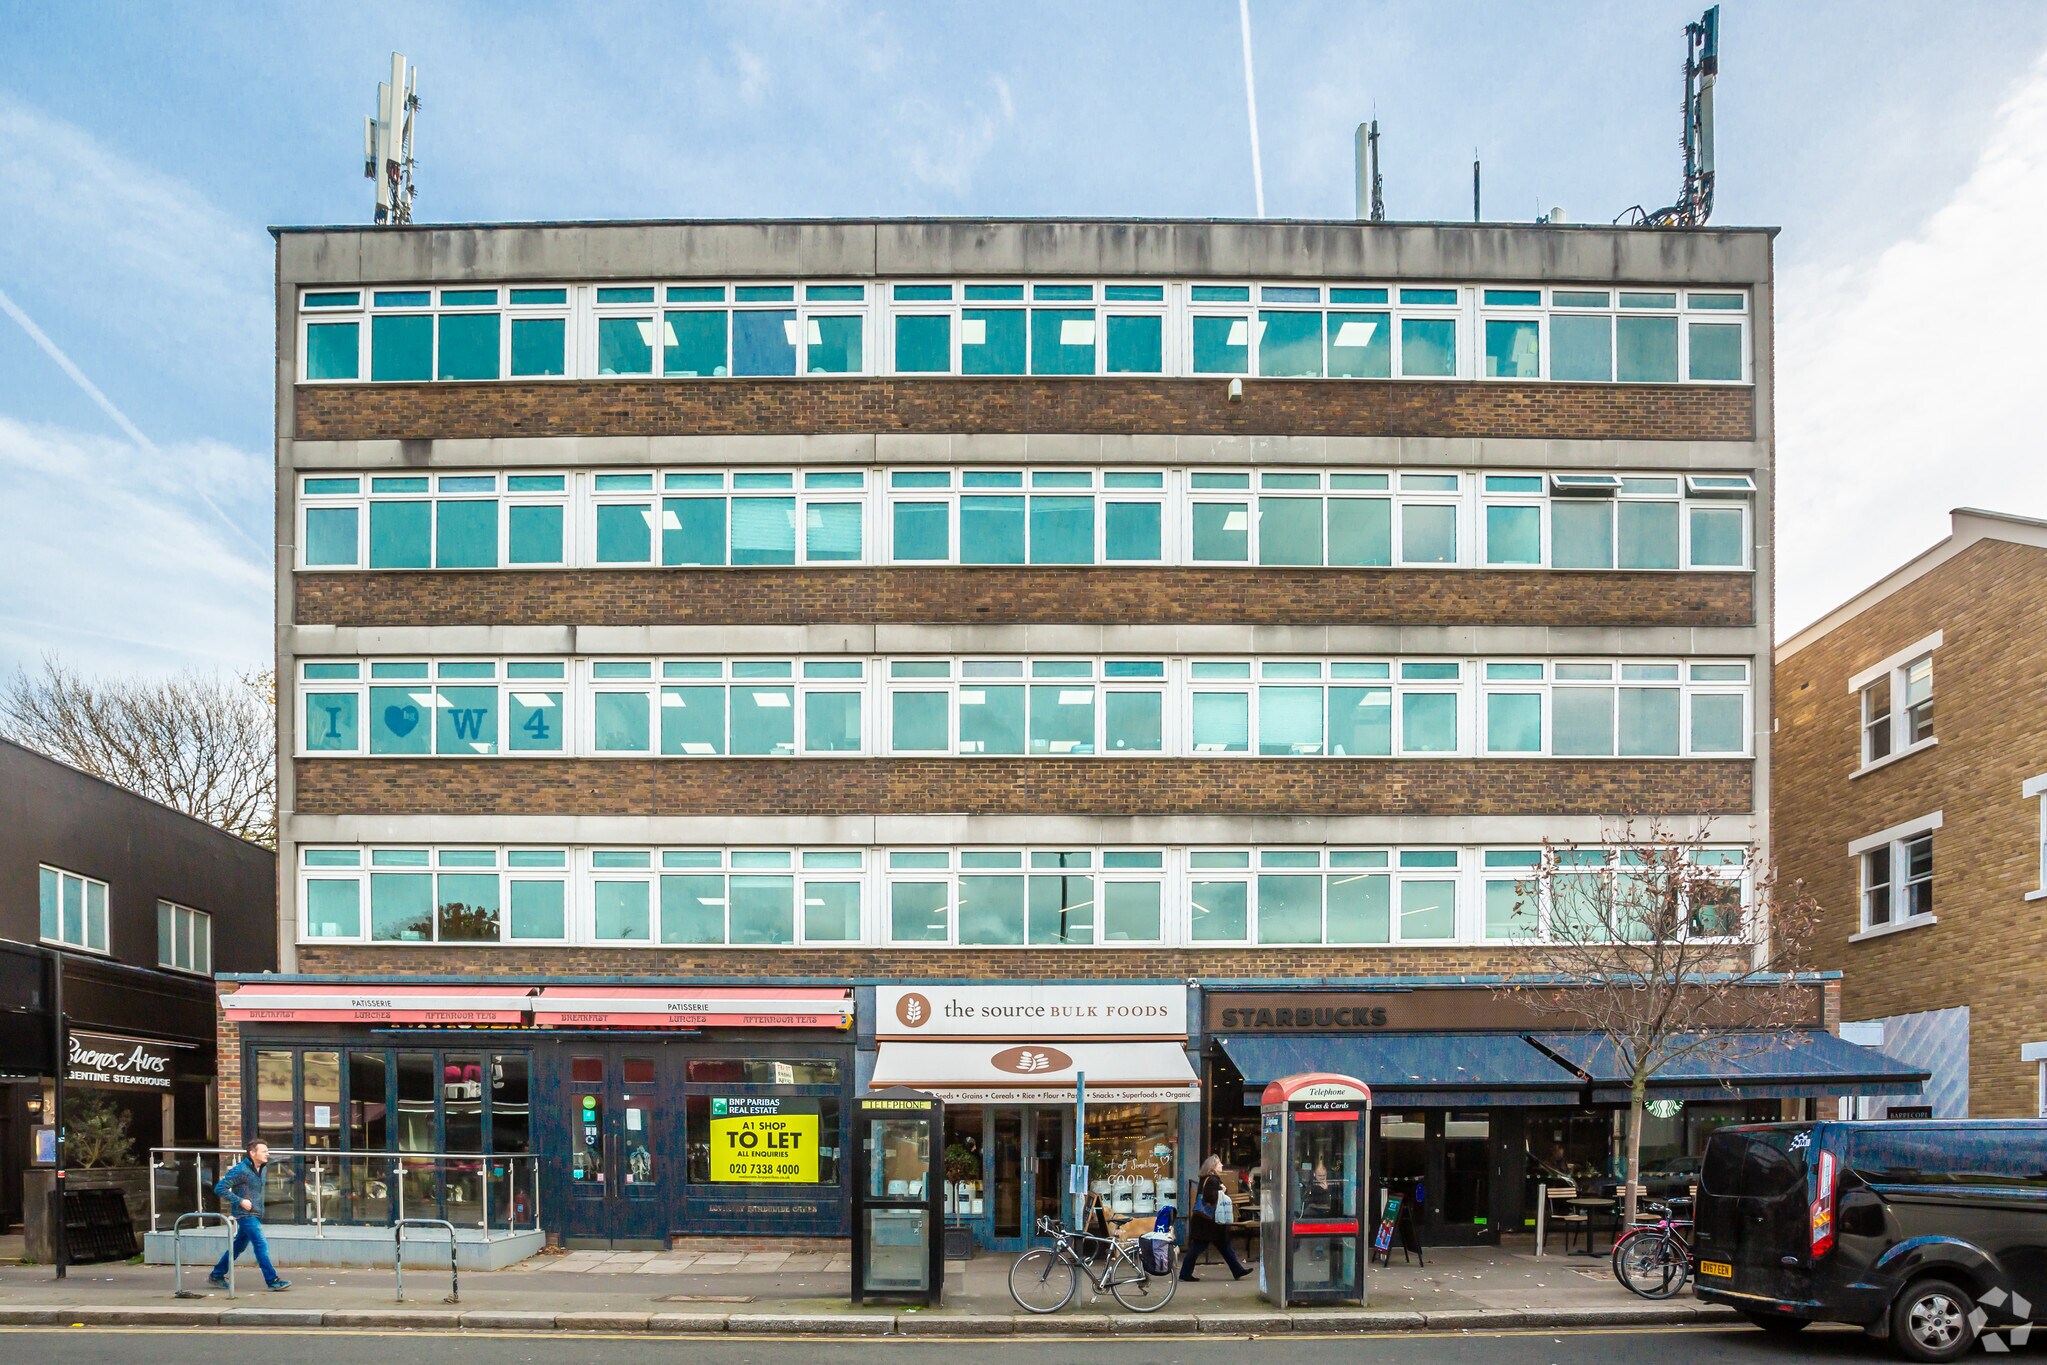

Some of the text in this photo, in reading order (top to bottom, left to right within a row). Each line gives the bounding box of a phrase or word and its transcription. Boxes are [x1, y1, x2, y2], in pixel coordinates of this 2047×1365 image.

[352, 1000, 392, 1008] PATISSERIE
[667, 1003, 709, 1011] PATISSERIE
[944, 999, 1168, 1018] the source BULK FOODS
[561, 1014, 608, 1022] BREAKFAST
[669, 1015, 707, 1023] LUNCHES
[796, 1016, 818, 1024] TEAS
[1222, 1007, 1387, 1027] STARBUCKS
[117, 1045, 170, 1072] Aires
[64, 1071, 170, 1087] GENTINE STEAKHOUSE
[961, 1092, 983, 1100] Grains
[990, 1092, 1014, 1100] Cereals
[1122, 1091, 1158, 1099] Superfoods
[1165, 1091, 1191, 1099] Organic
[1309, 1088, 1346, 1097] Telephone
[729, 1098, 780, 1106] BNP PARIBAS
[869, 1101, 925, 1110] TELEPHONE
[1304, 1102, 1323, 1110] Coins
[1323, 1102, 1329, 1110] &
[742, 1122, 786, 1130] A1 SHOP
[726, 1131, 802, 1149] TO LET
[729, 1163, 800, 1175] 020 7338 4000
[1107, 1174, 1144, 1186] GOOD
